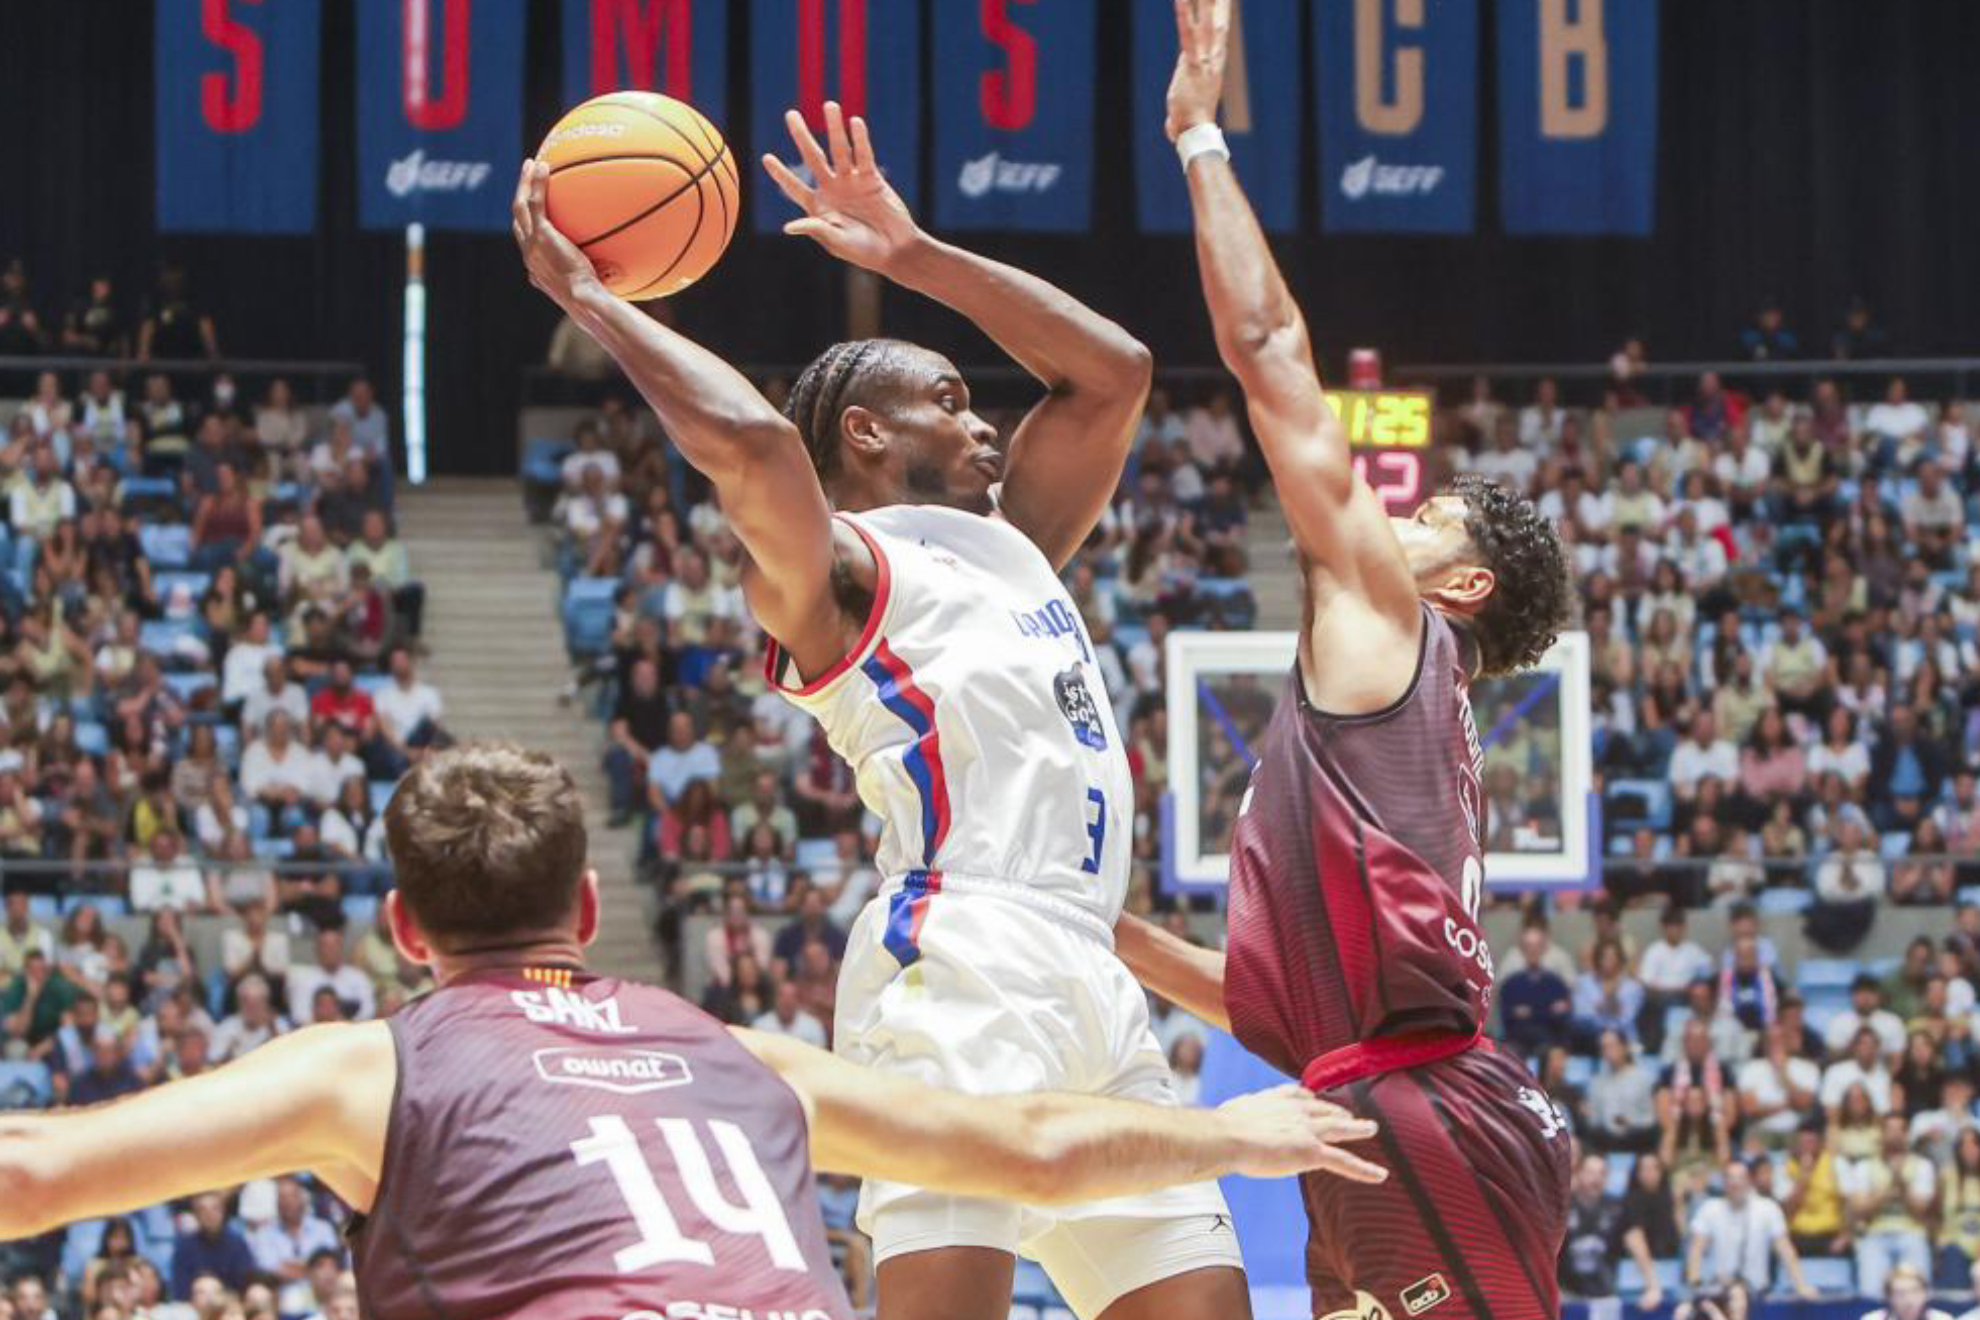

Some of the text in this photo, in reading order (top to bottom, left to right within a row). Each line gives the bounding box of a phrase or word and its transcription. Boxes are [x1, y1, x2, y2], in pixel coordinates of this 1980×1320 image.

[1081, 786, 1106, 875] 3
[562, 1056, 666, 1079] ownat
[569, 1114, 809, 1273] 14
